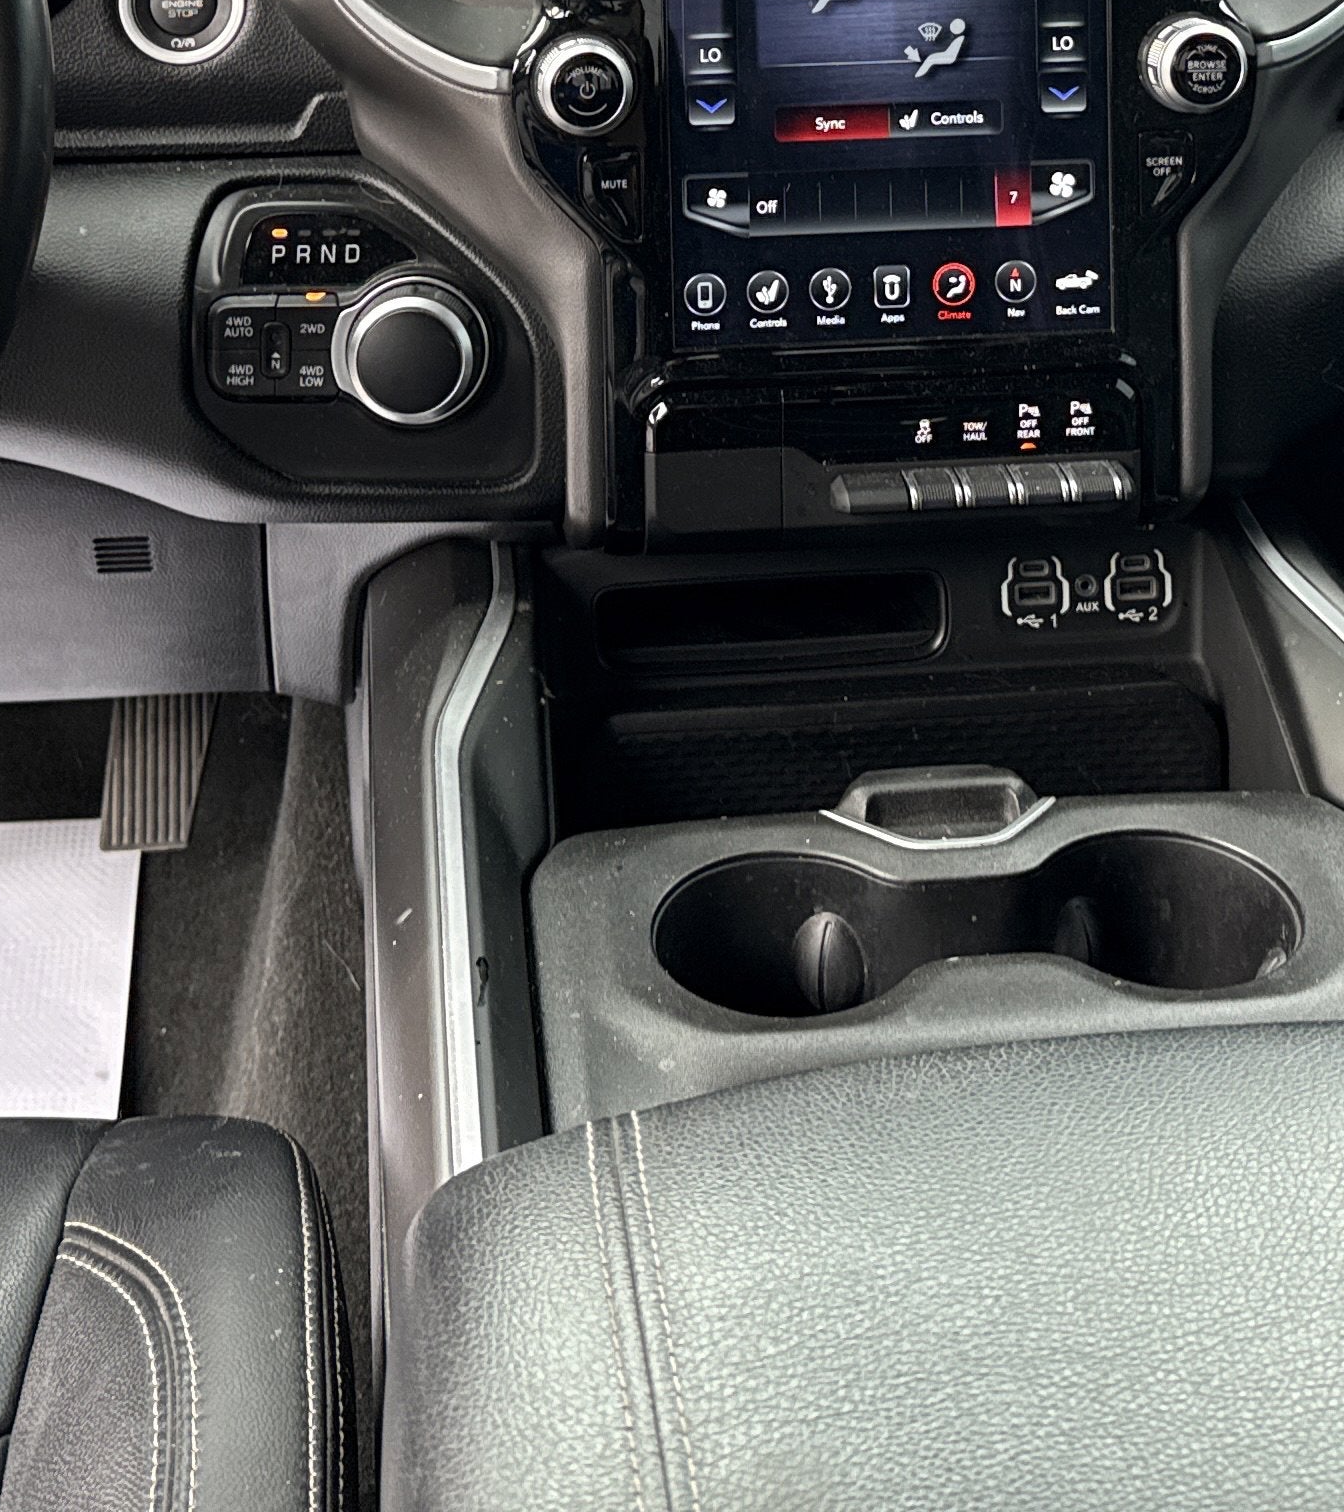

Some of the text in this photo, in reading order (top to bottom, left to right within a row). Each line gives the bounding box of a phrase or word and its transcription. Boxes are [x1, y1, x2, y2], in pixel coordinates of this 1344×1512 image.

[161, 0, 204, 9] ENGINE
[168, 9, 199, 18] STOP
[1051, 35, 1074, 51] LO
[699, 47, 722, 64] LO
[1187, 60, 1227, 70] BROWSE
[570, 66, 603, 78] VOLUME
[1192, 72, 1223, 81] ENTER
[930, 110, 985, 126] Controls
[814, 116, 846, 133] Sync
[1145, 155, 1184, 168] SCREEN
[1153, 166, 1172, 177] OFF
[600, 178, 628, 190] MUTE
[756, 191, 1019, 215] Off 7
[271, 243, 361, 264] P R N D
[937, 309, 972, 321] Climate
[1006, 307, 1026, 318] Nav
[1055, 304, 1101, 316] Back Cam
[225, 317, 252, 328] 4WD
[749, 317, 787, 329] Controls
[816, 314, 845, 326] Media
[880, 312, 905, 326] Apps
[300, 323, 326, 335] 2WD
[691, 320, 720, 331] Phone
[224, 327, 254, 338] AUTO
[271, 358, 281, 370] N
[228, 365, 254, 376] 4WD
[299, 365, 325, 376] 4WD
[226, 375, 255, 386] HIGH
[299, 376, 325, 387] LOW
[963, 421, 987, 432] TOW/
[1019, 419, 1038, 429] OFF
[1071, 416, 1089, 426] OFF
[963, 432, 987, 441] HAUL
[1016, 429, 1041, 438] REAR
[1065, 426, 1095, 437] FRONT
[914, 434, 933, 444] OFF
[1075, 601, 1100, 613] AUX
[1149, 606, 1159, 620] 2
[1050, 613, 1057, 628] 1
